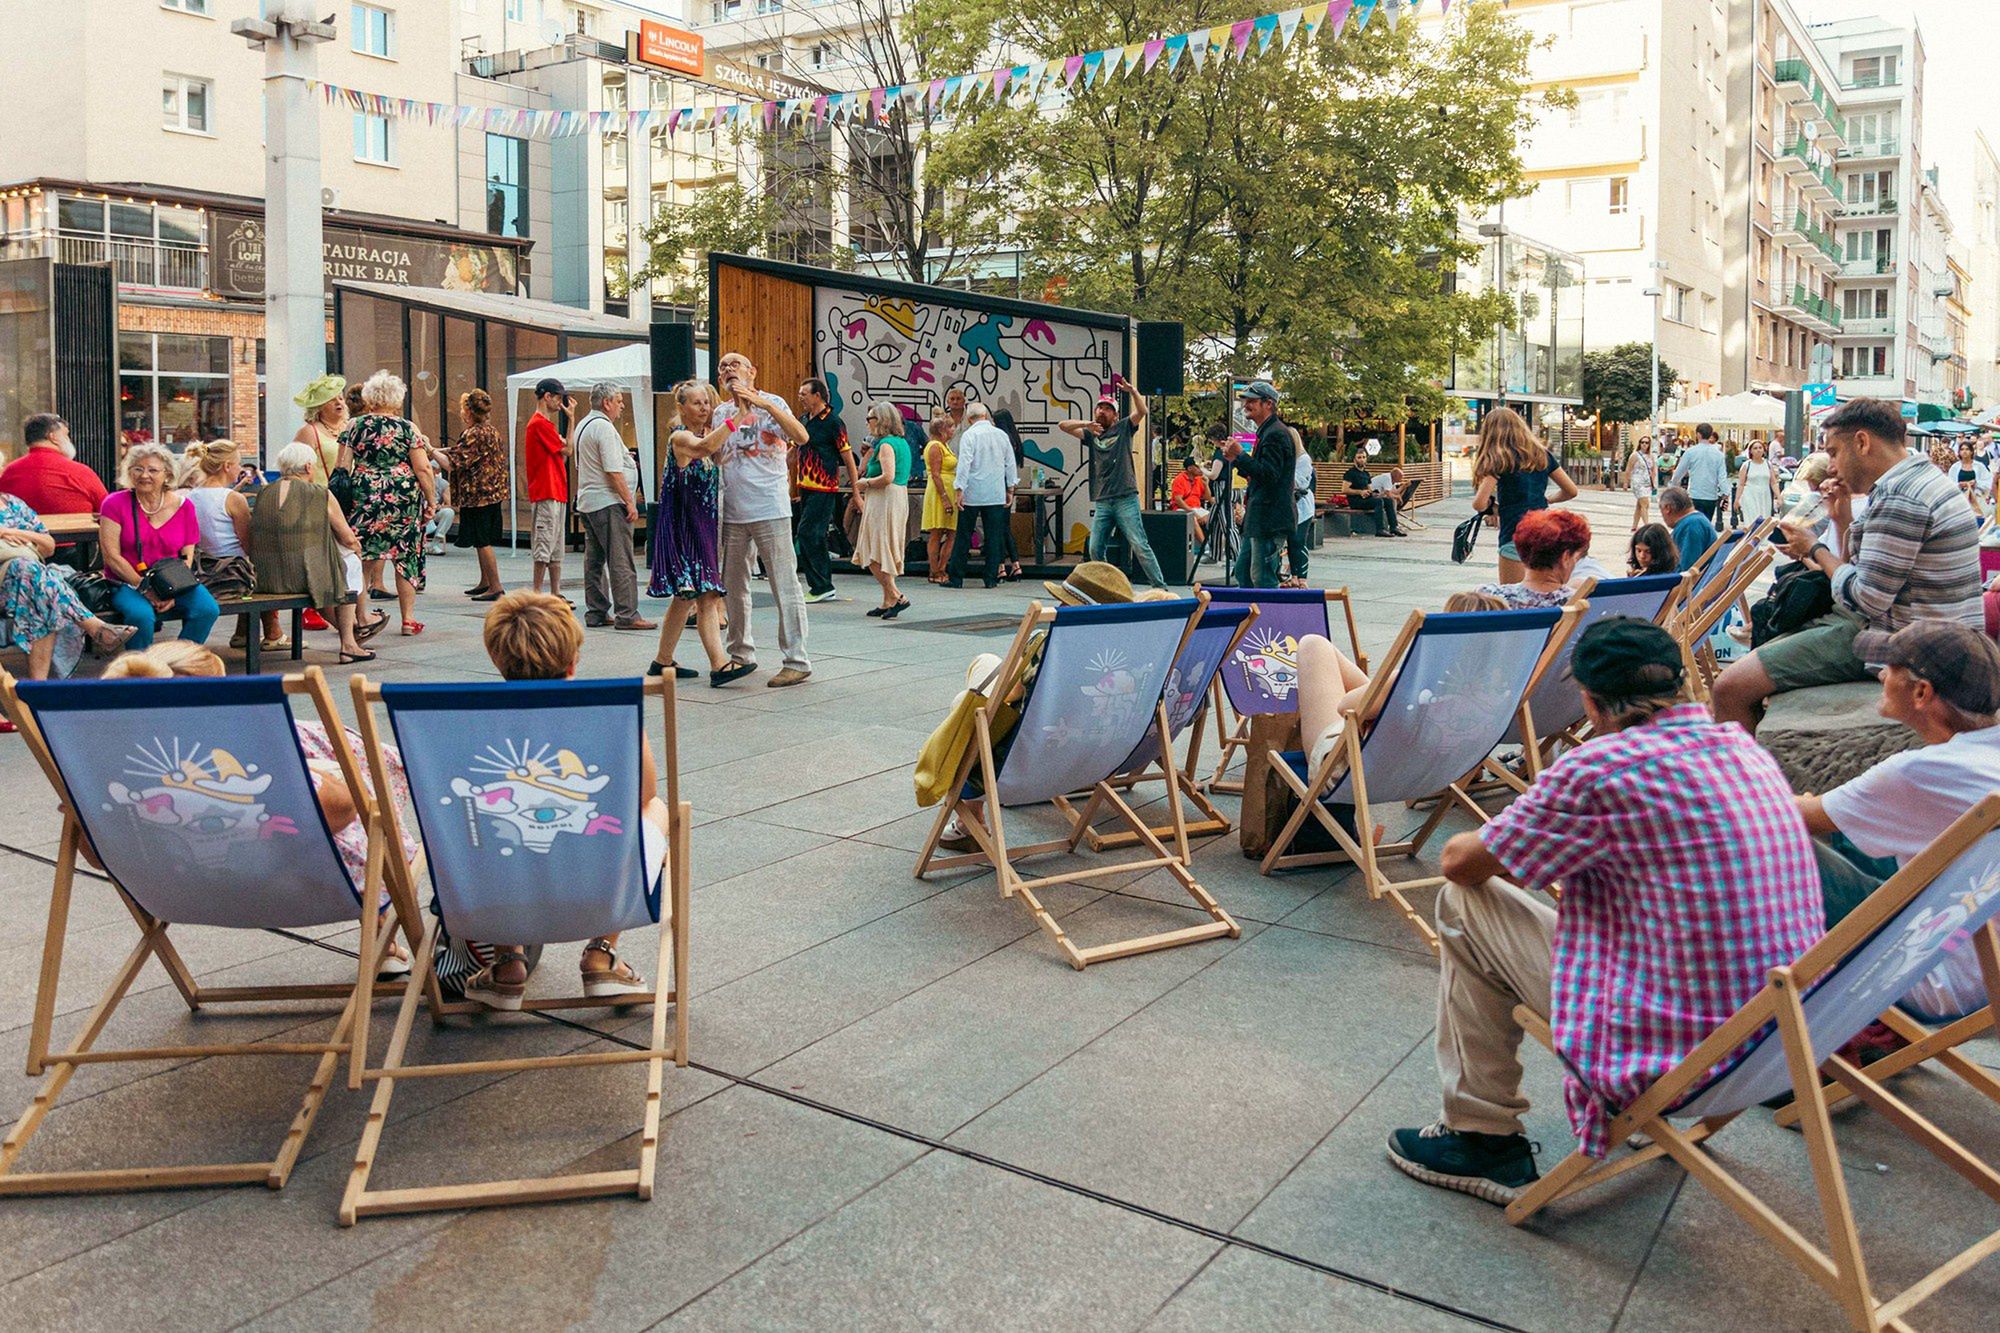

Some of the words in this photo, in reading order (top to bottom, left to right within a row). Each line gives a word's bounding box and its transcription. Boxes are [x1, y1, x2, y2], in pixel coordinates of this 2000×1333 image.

[238, 251, 262, 262] LOFT
[323, 243, 411, 267] TAURACJA
[323, 261, 367, 279] RINK
[374, 266, 409, 283] BAR
